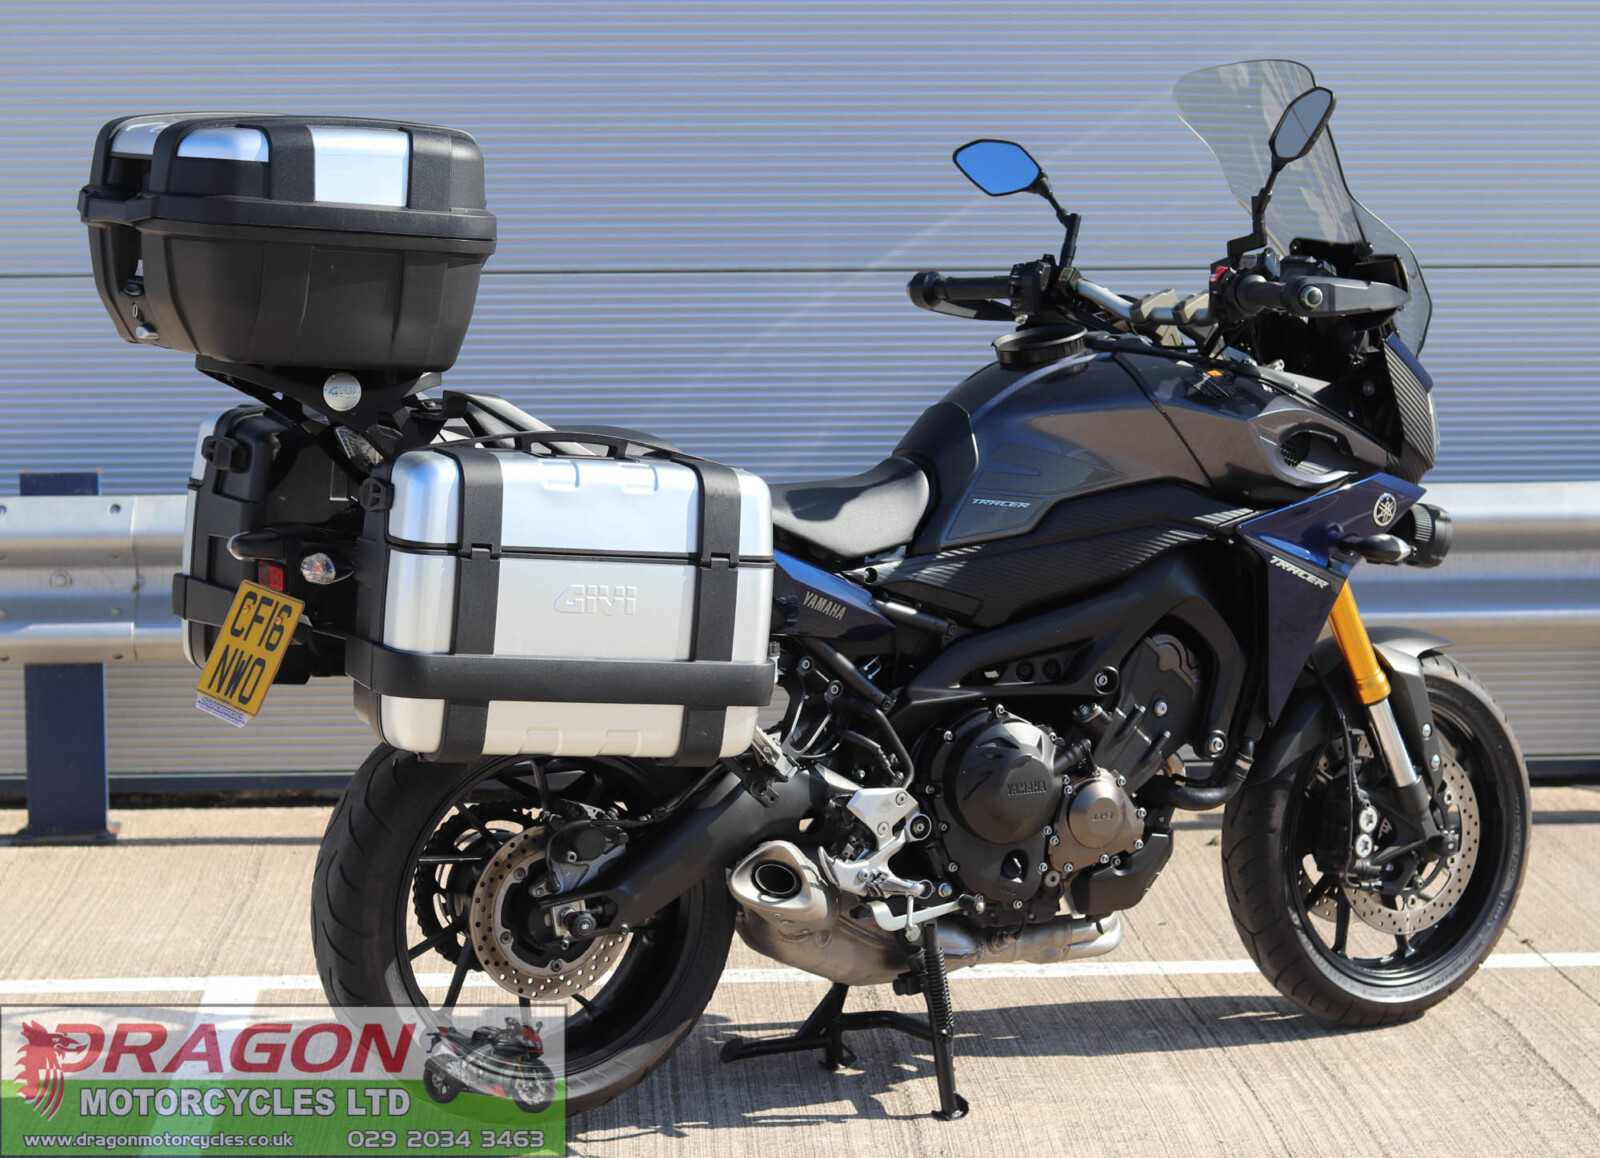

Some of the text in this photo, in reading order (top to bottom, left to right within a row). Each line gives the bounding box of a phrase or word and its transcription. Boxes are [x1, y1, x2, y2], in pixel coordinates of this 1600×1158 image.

[971, 498, 1031, 509] TRACER
[1270, 555, 1329, 589] TRACER
[230, 590, 293, 652] CF16
[802, 591, 847, 621] YAMAHA
[207, 643, 266, 705] NWO
[1006, 780, 1047, 797] YAMAHA
